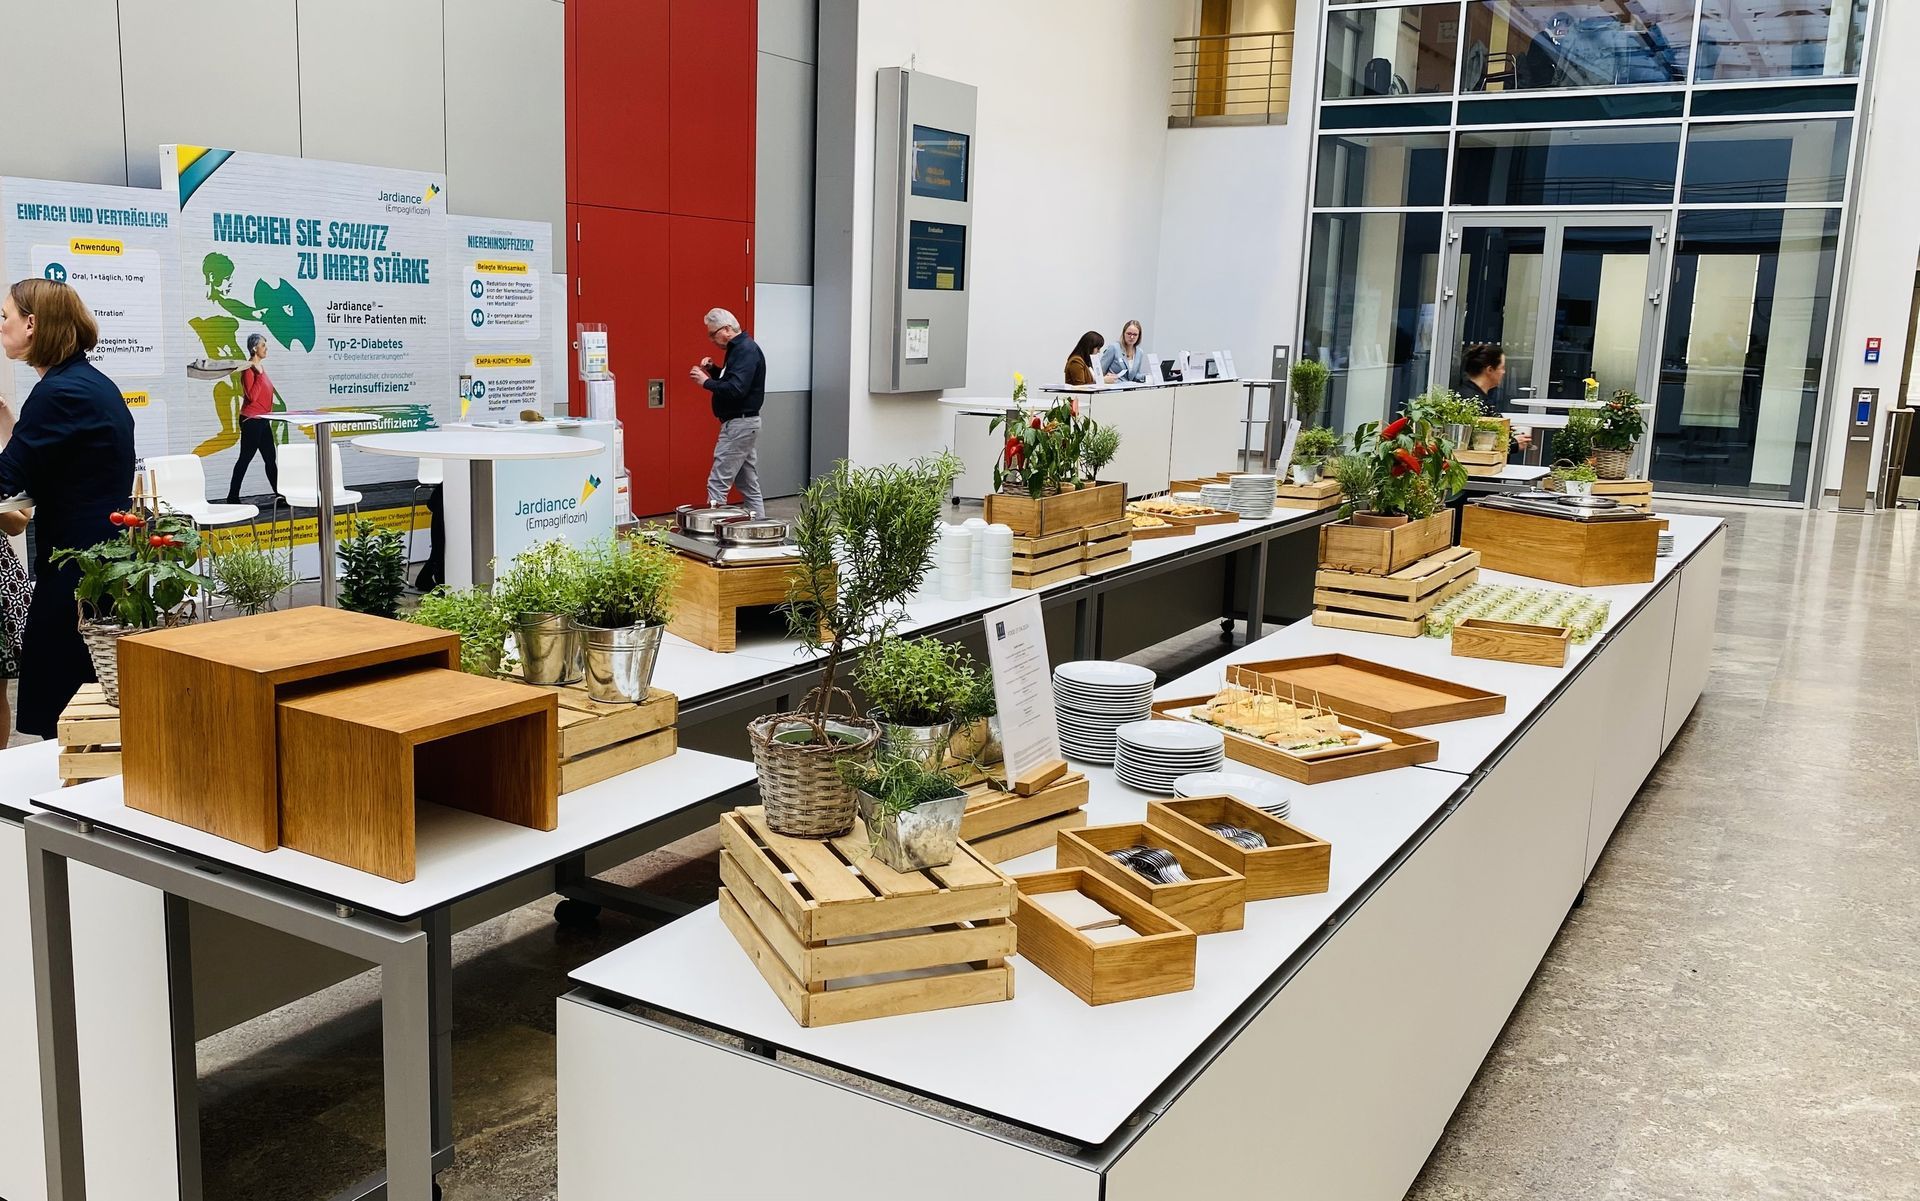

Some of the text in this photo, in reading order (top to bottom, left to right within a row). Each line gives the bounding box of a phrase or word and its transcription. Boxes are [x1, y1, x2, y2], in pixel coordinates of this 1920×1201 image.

[377, 190, 422, 204] Jardiance
[16, 203, 169, 228] EINFACH UND VERTRÄGLICH
[385, 204, 431, 216] (Empagliflozin)
[212, 212, 389, 250] MACHEN SIE SCHUTZ
[74, 242, 120, 254] Anwendung
[467, 235, 534, 251] NIERENINSUFFIZIENZ
[297, 252, 430, 284] ZU IHRER STÄRKE
[477, 263, 526, 272] Belegte Wirksamkeit
[72, 273, 89, 281] Oral,
[98, 273, 124, 282] täglich,
[125, 274, 133, 282] 10
[326, 313, 427, 325] für Ihre Patienten mit:
[327, 338, 403, 351] Typ-2-Diabetes
[514, 497, 577, 516] Jardiance
[526, 511, 588, 531] (Empagliflozin)
